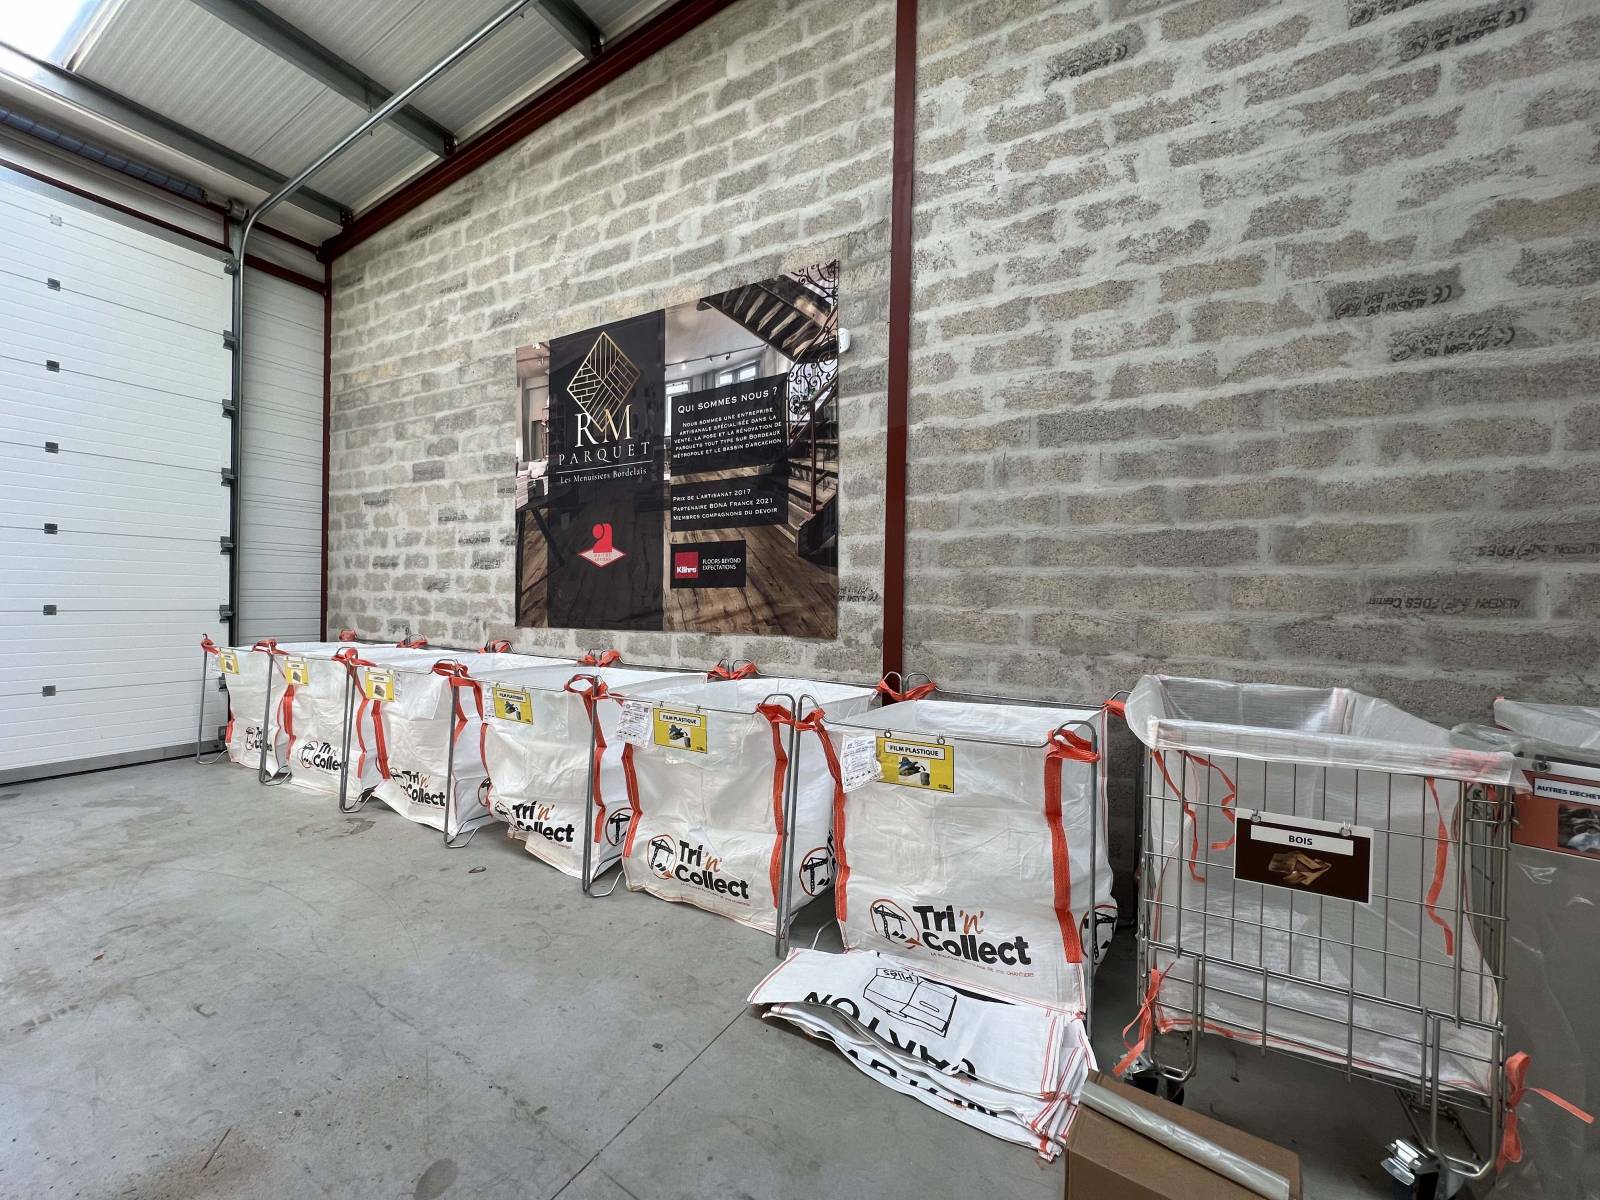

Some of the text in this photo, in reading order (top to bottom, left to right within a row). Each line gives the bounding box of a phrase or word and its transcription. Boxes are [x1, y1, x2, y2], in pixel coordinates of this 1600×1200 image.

[678, 405, 694, 414] QUI
[697, 396, 737, 410] SOMMES
[741, 389, 769, 401] NOUS
[737, 408, 773, 418] ENTREPRISE
[558, 441, 650, 466] PARQUET
[560, 467, 647, 484] Les Menuisiers Bordelais
[734, 488, 751, 496] 2017
[754, 507, 778, 515] DEVOIR
[905, 747, 939, 757] PLASTIQUE
[313, 754, 347, 771] Colle
[406, 783, 446, 807] Collect
[1536, 785, 1568, 795] AUTRES
[512, 800, 537, 820] Tri
[1288, 834, 1313, 846] BOIS
[679, 840, 703, 867] Tri
[674, 864, 750, 900] Collect
[912, 904, 956, 932] Tri
[922, 931, 1032, 966] Collect
